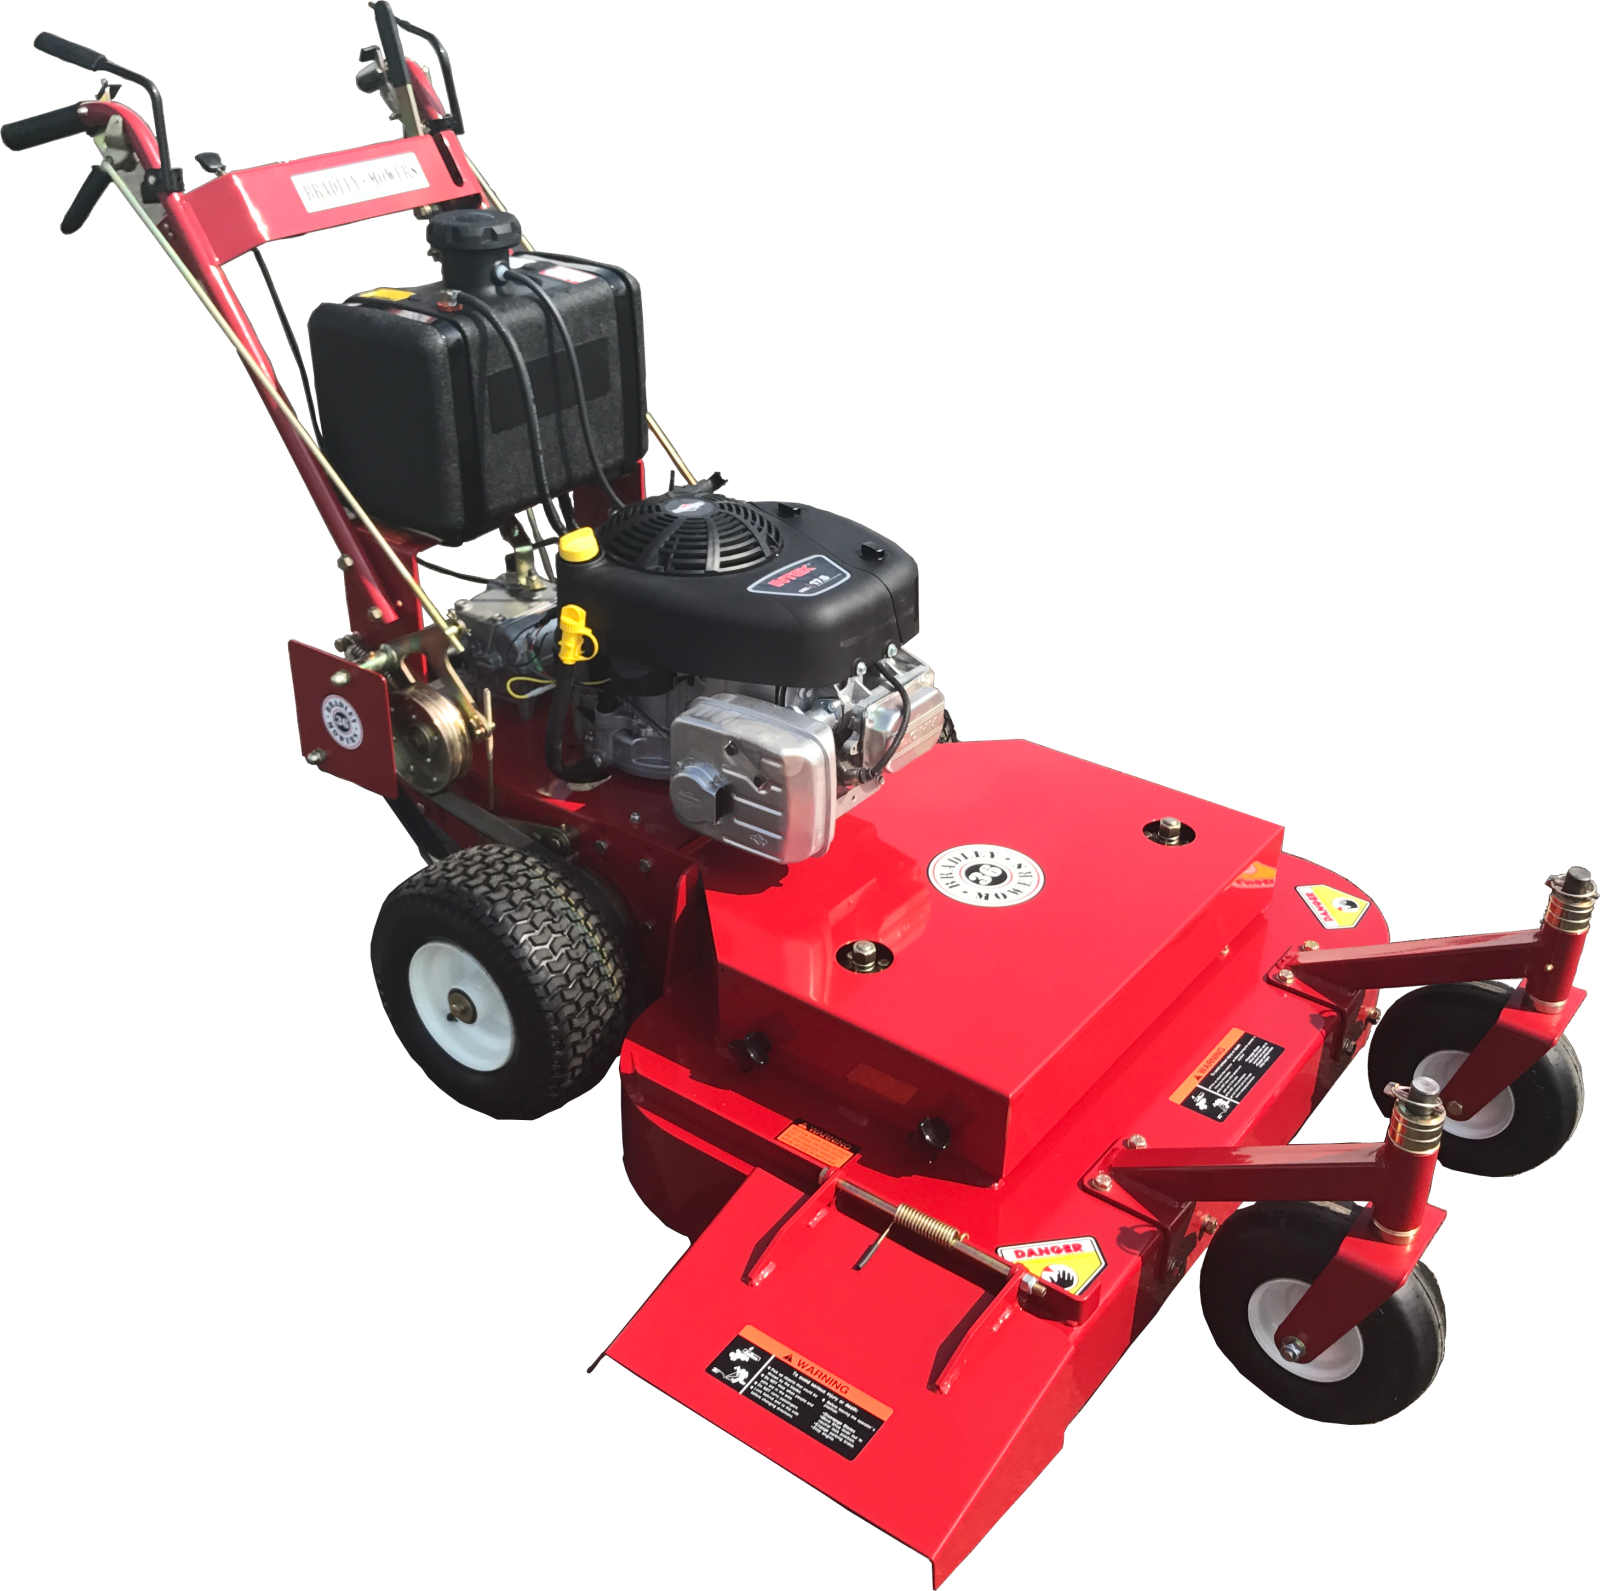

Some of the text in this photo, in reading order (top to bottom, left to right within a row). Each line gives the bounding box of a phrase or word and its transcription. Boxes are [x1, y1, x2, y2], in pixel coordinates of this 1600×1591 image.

[940, 850, 999, 889] BRADLEY
[968, 863, 1003, 886] 36
[976, 863, 1033, 901] MOWERS
[1305, 892, 1333, 922] DANGER
[1200, 1046, 1226, 1075] WARNING
[809, 1125, 852, 1150] WARNING
[1013, 1242, 1084, 1259] DANGER
[796, 1358, 850, 1395] WARNING
